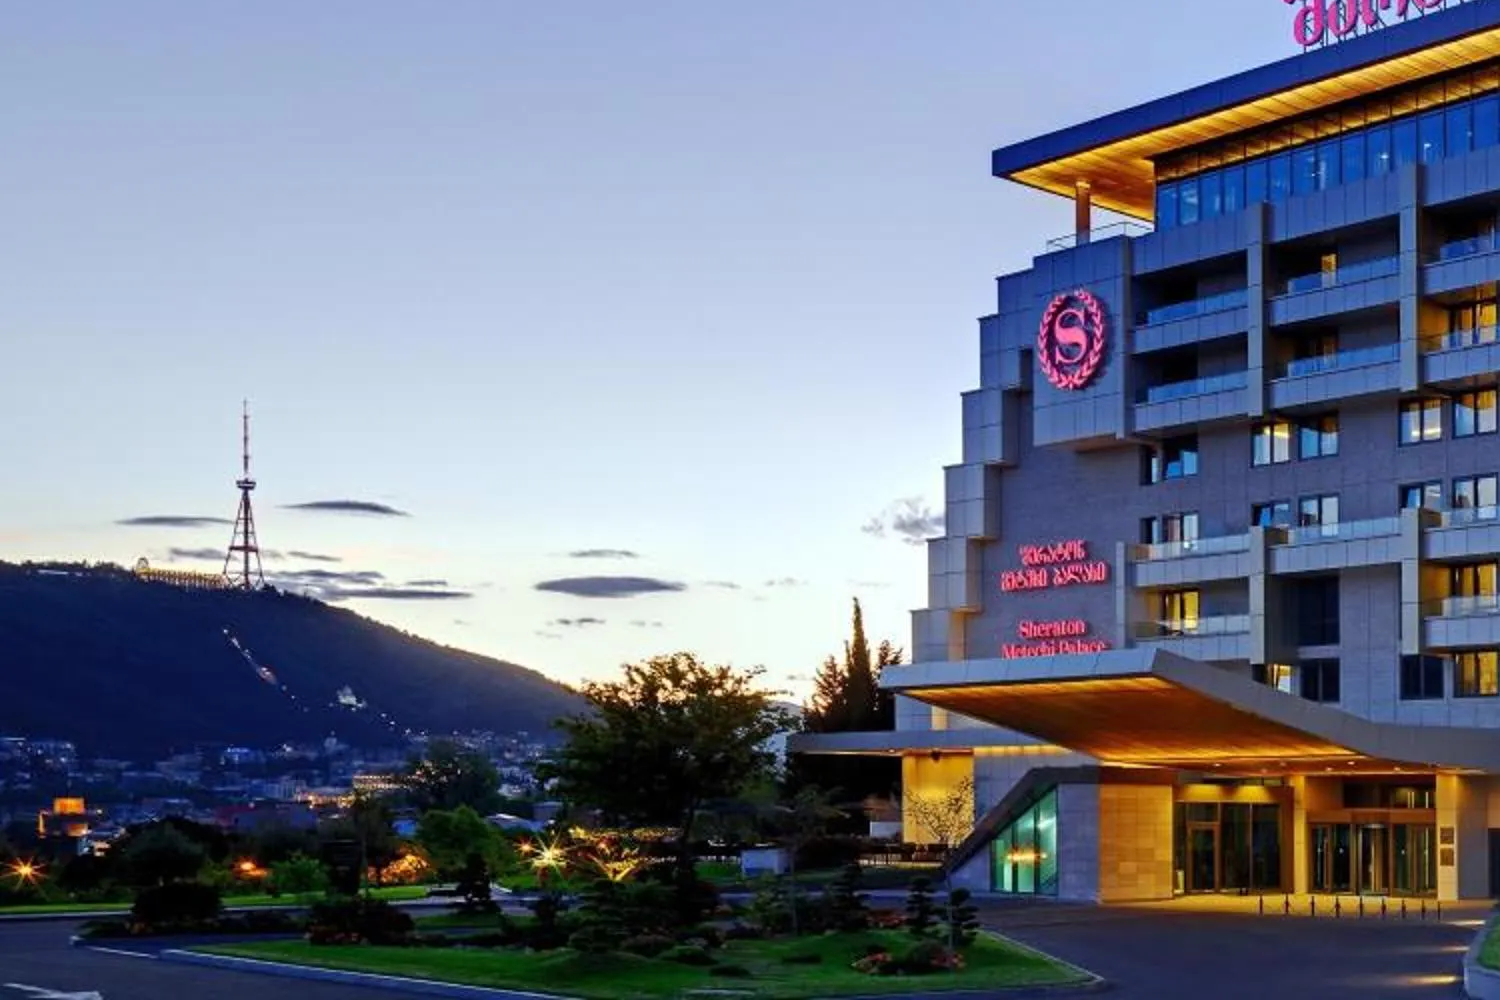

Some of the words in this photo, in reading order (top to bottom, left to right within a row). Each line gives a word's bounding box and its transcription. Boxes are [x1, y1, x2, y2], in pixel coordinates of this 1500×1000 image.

[1055, 308, 1088, 364] S
[1019, 619, 1085, 638] Sheraton
[1059, 639, 1105, 655] Palace
